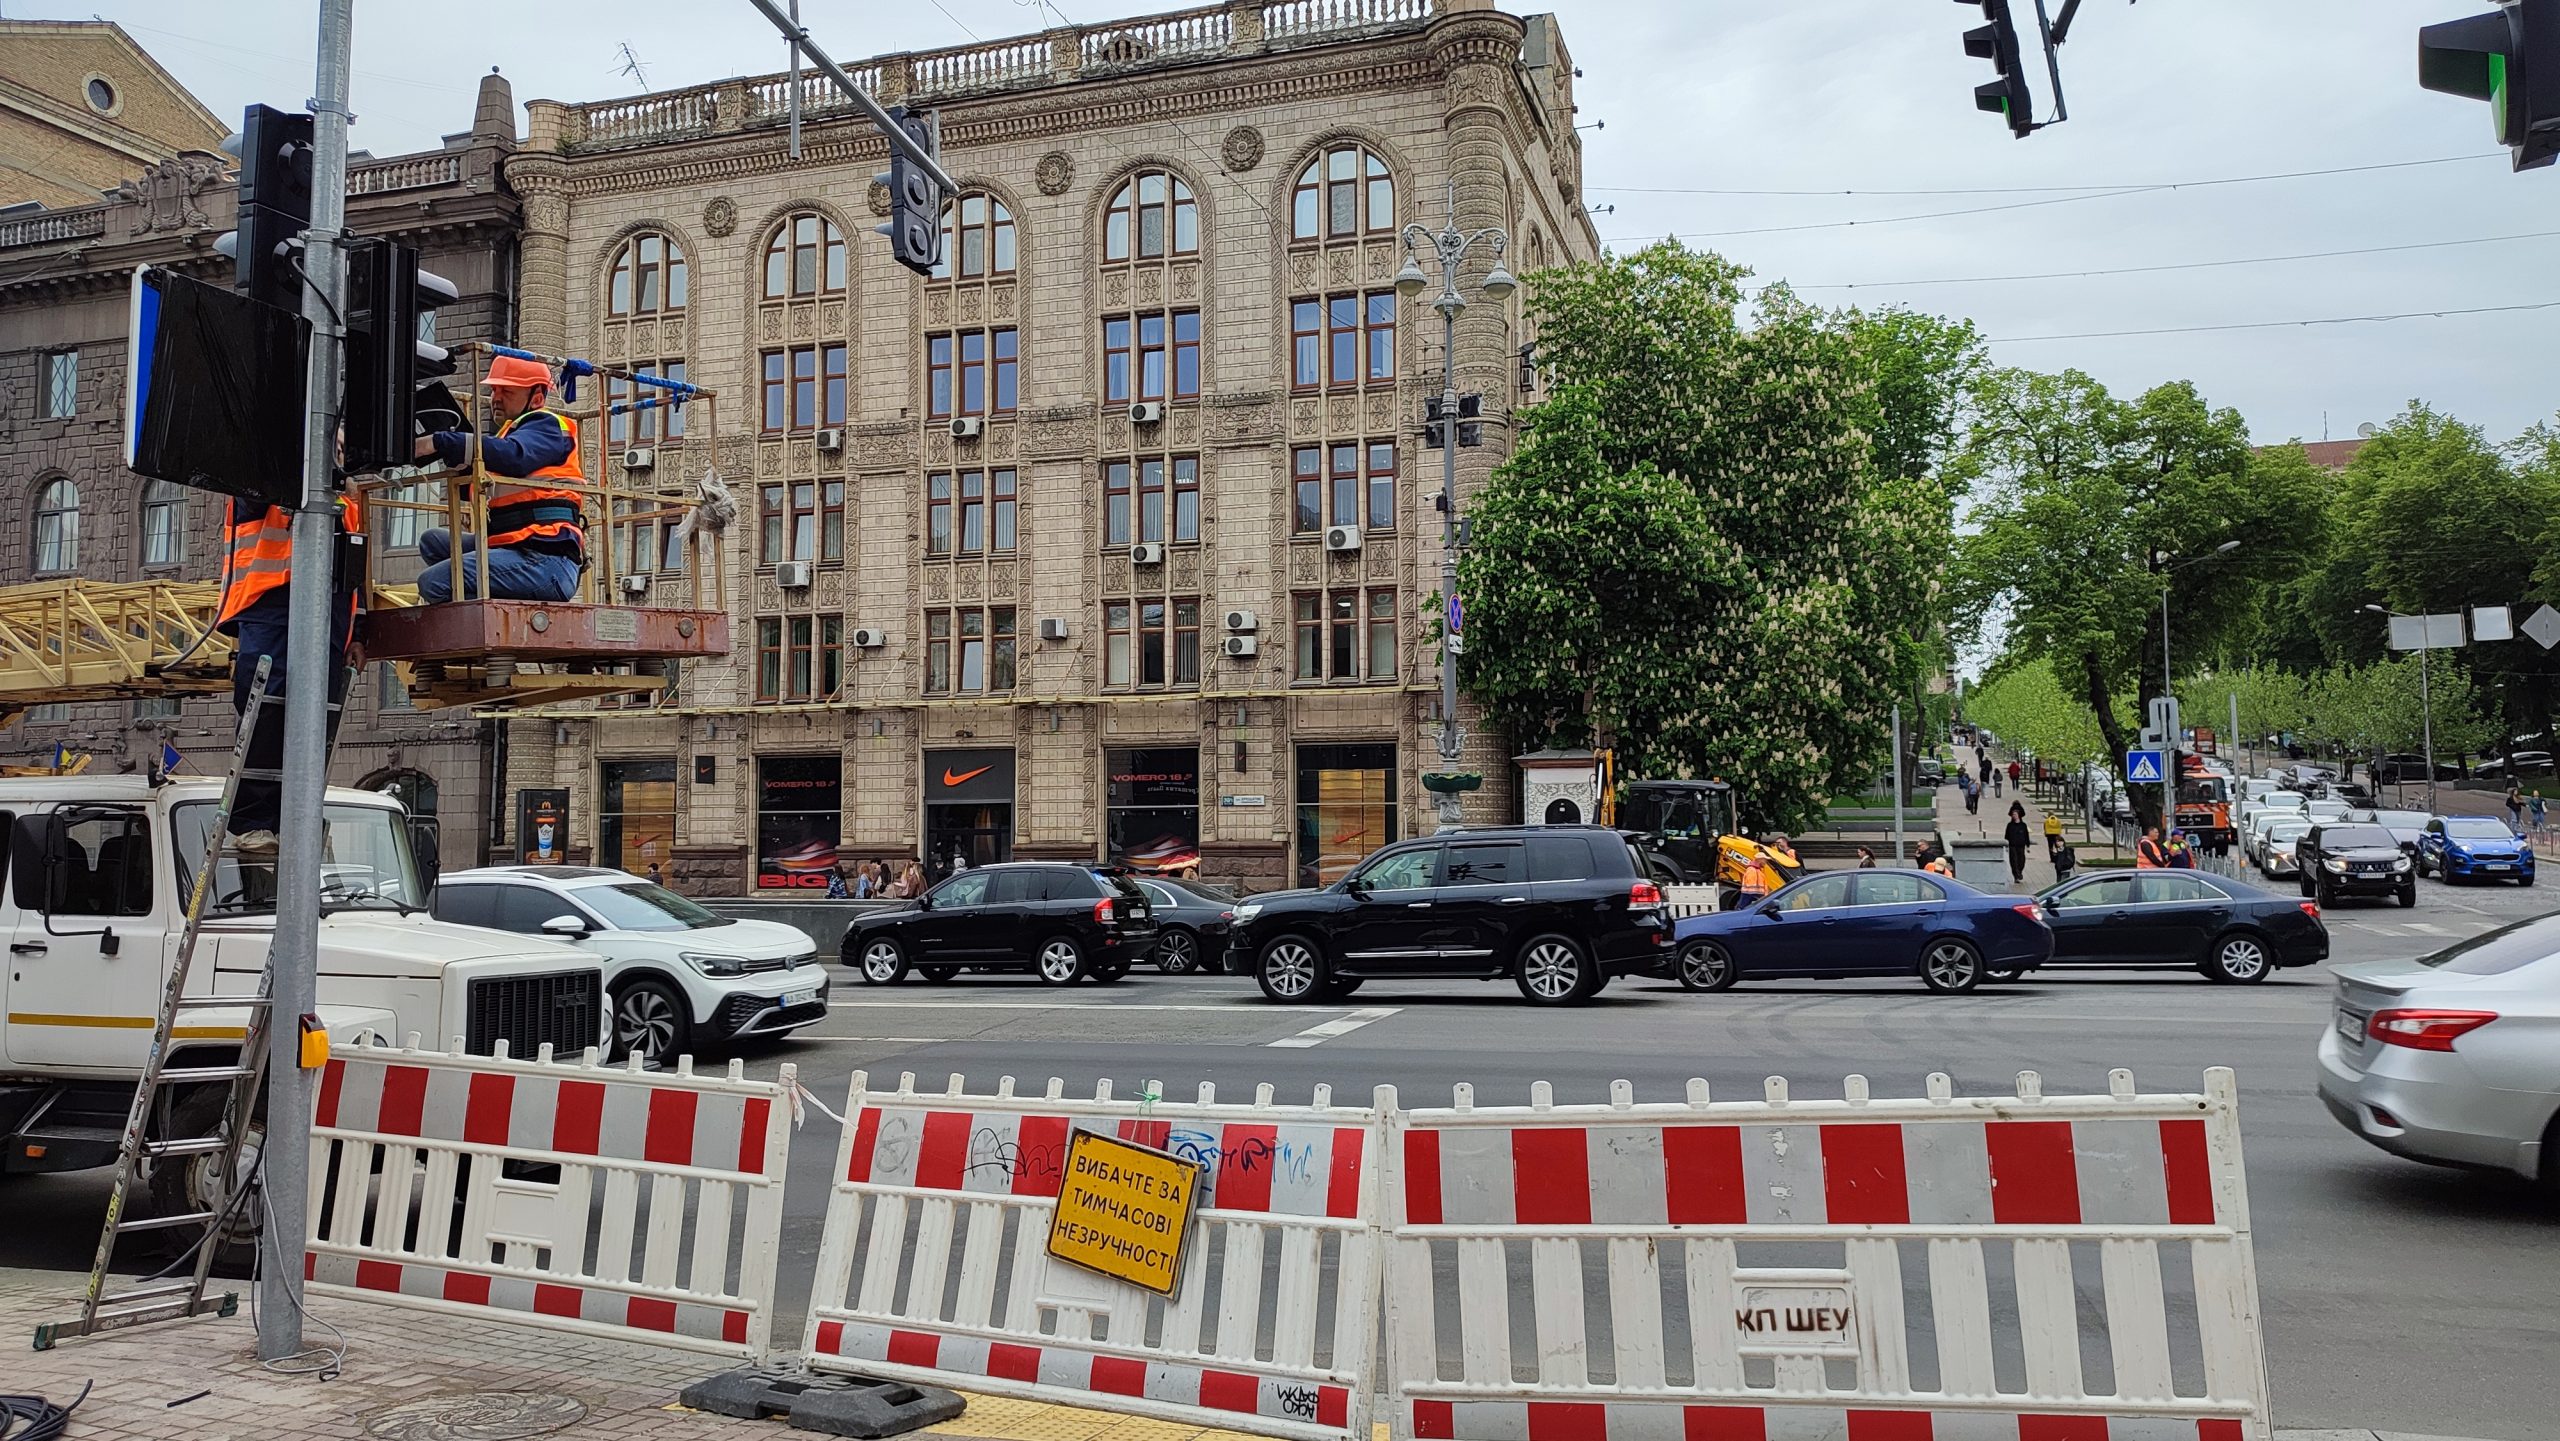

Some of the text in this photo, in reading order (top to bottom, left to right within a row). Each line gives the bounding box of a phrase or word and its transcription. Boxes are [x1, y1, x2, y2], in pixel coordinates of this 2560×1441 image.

[1112, 773, 1182, 782] VOMERO 18
[759, 874, 828, 887] BIG
[1075, 1155, 1154, 1195] ВИБАЧТЕ
[1158, 1181, 1181, 1204] ЗА
[1073, 1187, 1172, 1235] ТИМЧАСОВІ
[1056, 1219, 1174, 1274] НЕЗРУЧНОСТІ
[1735, 1307, 1849, 1332] КП ШЕУ
